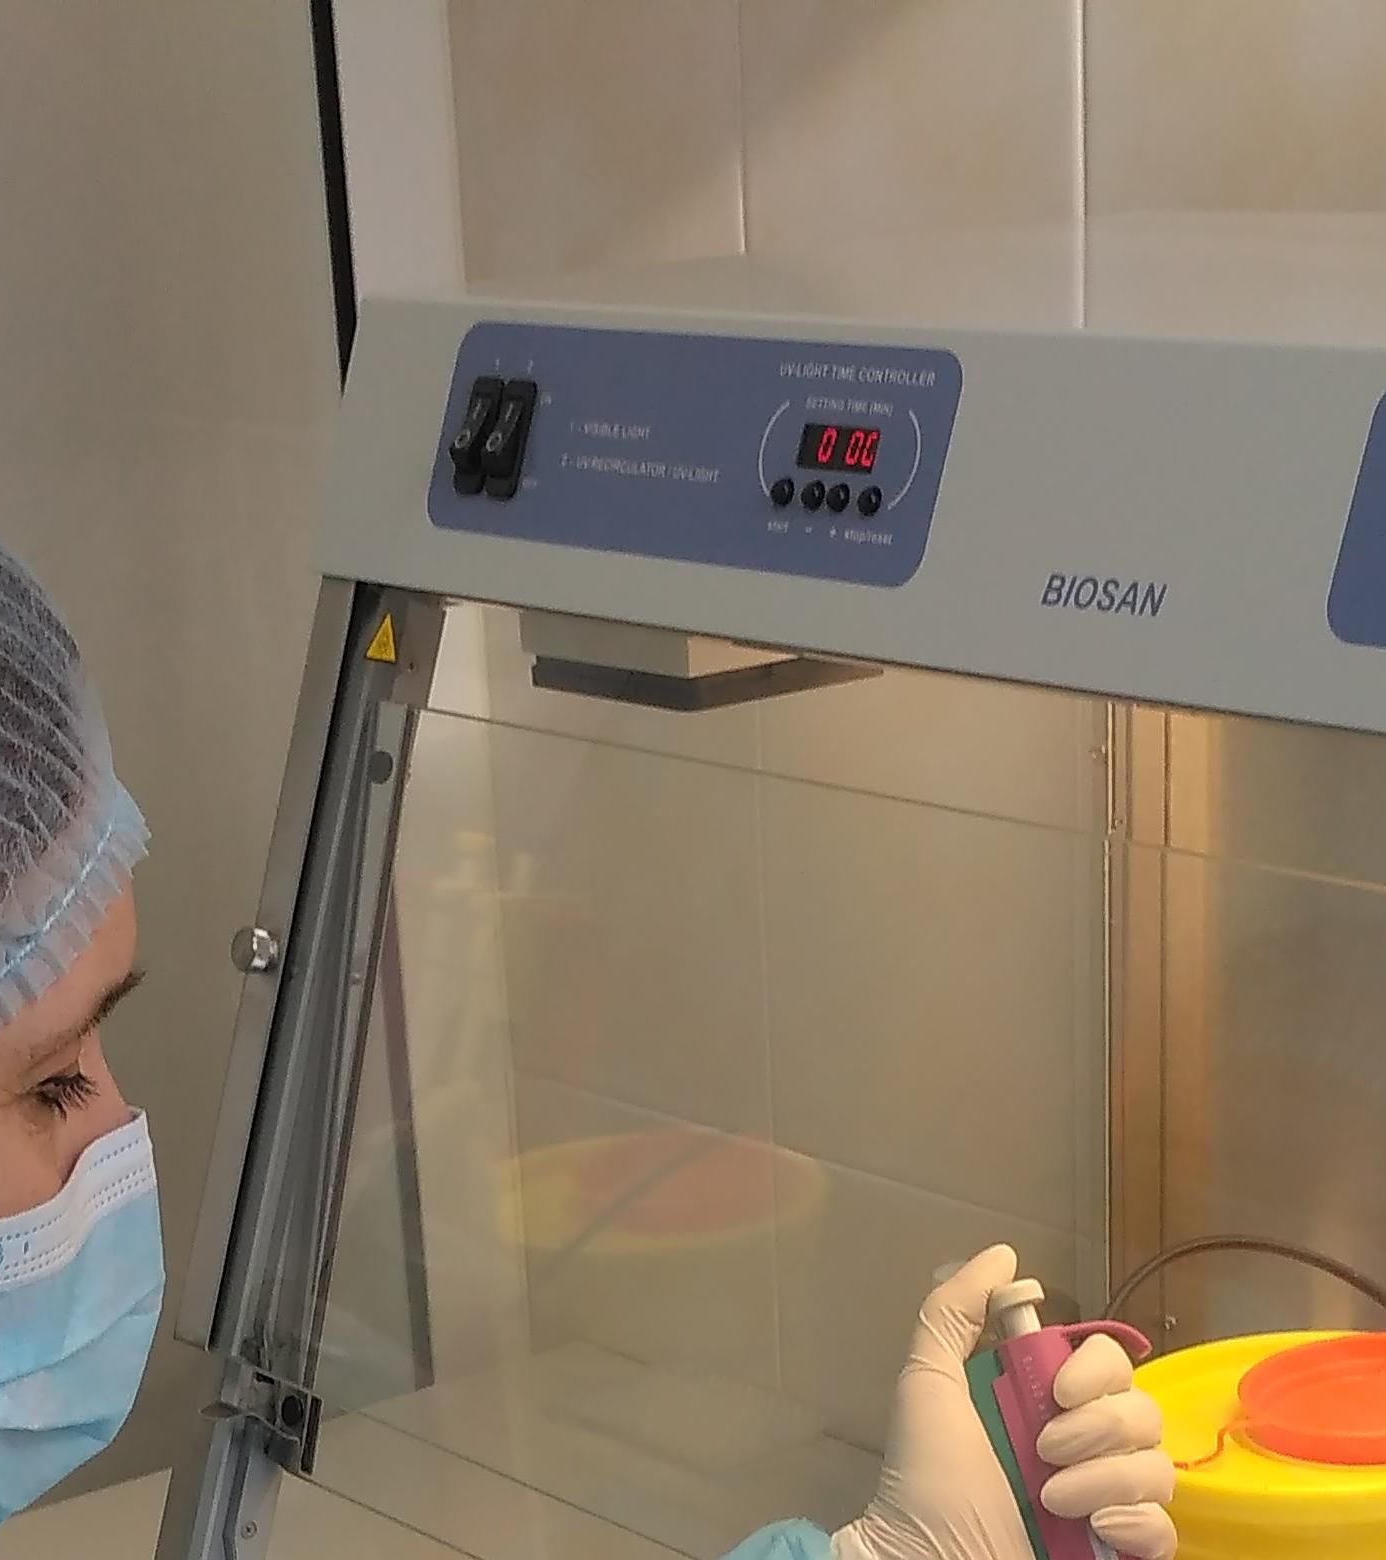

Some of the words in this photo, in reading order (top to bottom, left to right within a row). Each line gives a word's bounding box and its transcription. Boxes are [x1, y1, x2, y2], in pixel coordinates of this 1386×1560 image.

[780, 362, 828, 379] UV-LIGHT
[831, 364, 856, 381] TIME
[858, 367, 935, 386] CONTROLLER
[591, 456, 665, 478] RECIRCULATOR
[1040, 573, 1168, 617] BIOSAN
